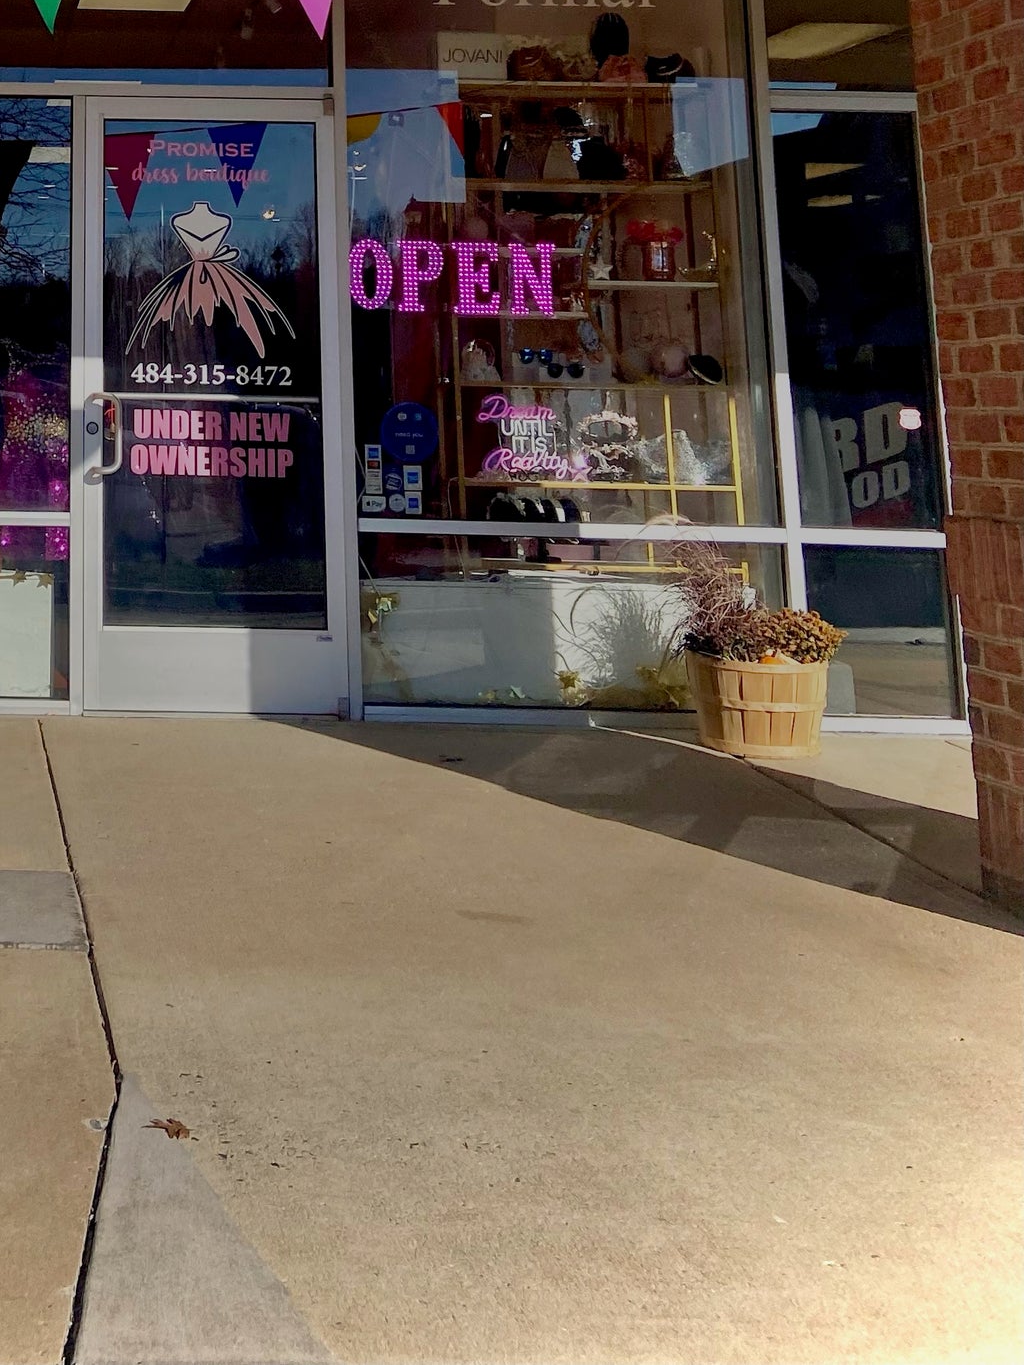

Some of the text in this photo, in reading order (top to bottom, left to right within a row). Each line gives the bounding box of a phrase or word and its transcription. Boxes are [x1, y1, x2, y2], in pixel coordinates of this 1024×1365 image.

[442, 48, 503, 65] JOVANI
[131, 162, 271, 190] dress boutique
[348, 238, 557, 317] OPEN
[130, 362, 293, 386] 484-315-8472
[478, 395, 557, 421] Dream
[133, 408, 291, 443] UNDER NEW
[500, 418, 555, 437] UNTIL
[511, 435, 549, 455] IT IS
[130, 443, 295, 479] OWNERSHIP
